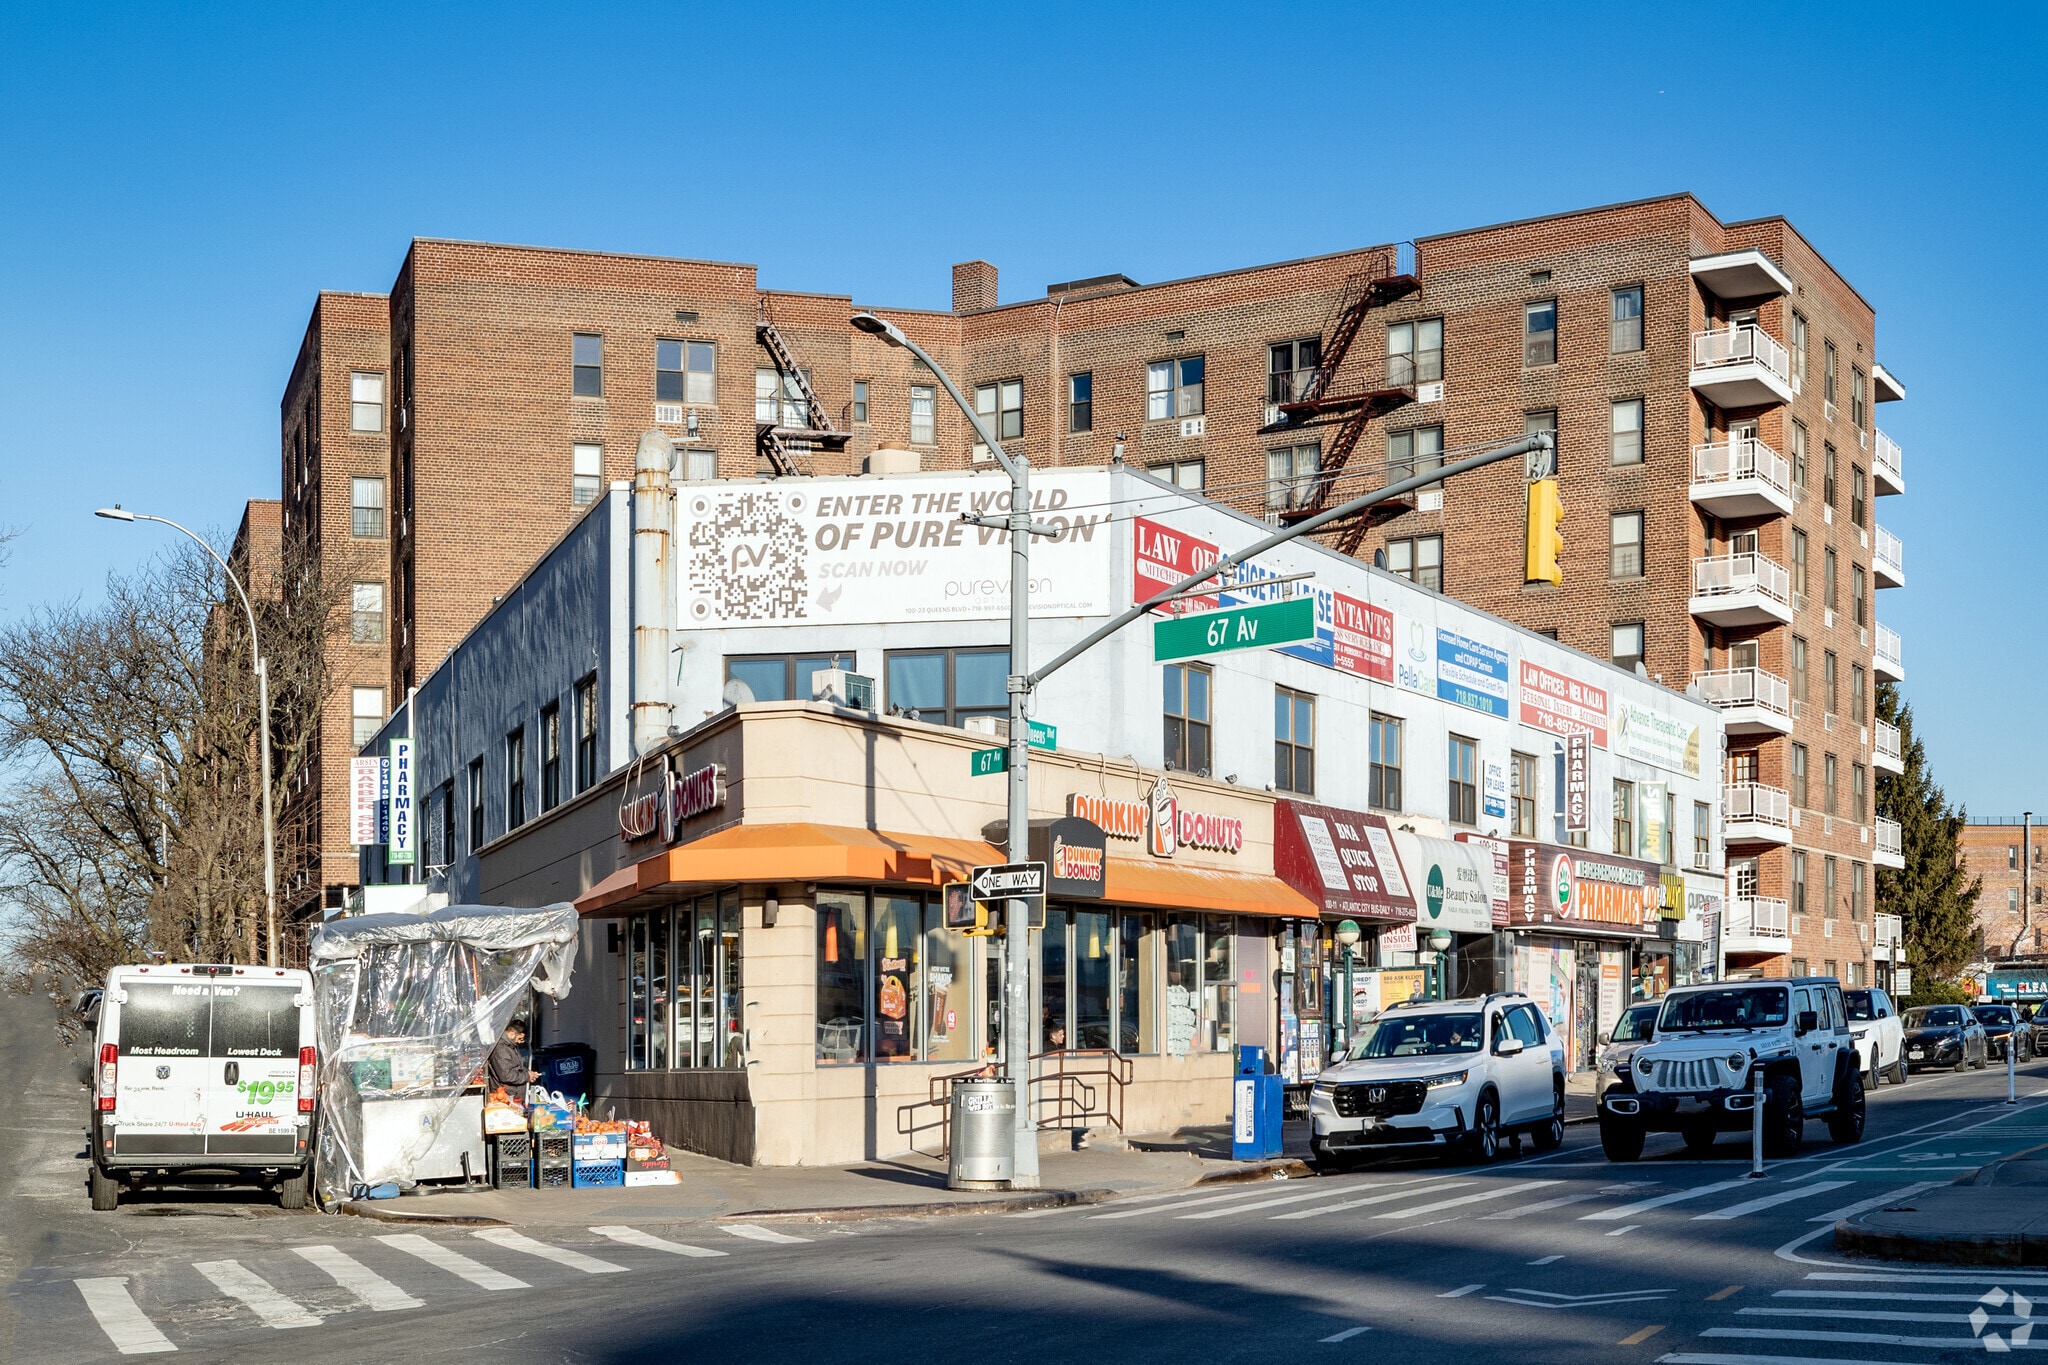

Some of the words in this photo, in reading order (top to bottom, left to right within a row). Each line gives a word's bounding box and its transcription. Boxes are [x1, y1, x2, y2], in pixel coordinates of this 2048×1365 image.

[816, 494, 903, 517] ENTER
[911, 491, 962, 514] THE
[970, 489, 1068, 512] WOLD
[815, 522, 864, 551] OF
[870, 518, 962, 549] PURE
[977, 515, 1098, 546] VIION
[1139, 526, 1181, 566] LAW
[818, 562, 873, 579] SCAN
[877, 559, 928, 577] NOW
[927, 606, 951, 614] QUEENS
[1028, 602, 1092, 611] EVISIONOPTICAL.COM
[1334, 599, 1391, 640] NTANTS
[1207, 618, 1229, 647] 67
[1237, 615, 1258, 642] Av
[1399, 663, 1436, 694] PellaCare
[1523, 664, 1538, 687] LAW
[1539, 670, 1564, 697] OFFICES
[1583, 686, 1604, 711] KALRA
[1522, 688, 1551, 709] PERSONAL
[980, 752, 991, 772] 67
[1489, 763, 1502, 778] OFFICE
[358, 769, 374, 810] BARBER
[1570, 737, 1585, 825] PHARMACY
[395, 744, 410, 848] PHARMACY
[675, 766, 715, 820] DONUTS
[358, 815, 374, 842] SHOP
[1183, 811, 1243, 850] DONUTS
[1335, 822, 1360, 842] BNA
[1067, 846, 1102, 863] DUNKIN'
[1340, 847, 1375, 869] QUICK
[981, 875, 1001, 889] ONE
[1012, 873, 1036, 886] WAY
[1067, 863, 1101, 881] DONUTS
[1352, 873, 1378, 893] STOP
[1522, 848, 1538, 922] PHARMACY
[1446, 887, 1469, 904] Beauty
[1469, 890, 1488, 904] Salon
[1577, 882, 1644, 925] PHARMACY
[1342, 901, 1361, 912] ATLANTIC
[1361, 903, 1370, 913] CITY
[1386, 923, 1410, 935] ATM
[1383, 935, 1412, 944] INSIDE
[172, 985, 201, 996] Need
[202, 987, 209, 996] a
[214, 985, 241, 996] Van?
[130, 1046, 153, 1056] Most
[154, 1046, 199, 1056] Headroom
[227, 1047, 259, 1056] Lowest
[260, 1048, 282, 1057] Deck
[422, 1115, 431, 1125] A
